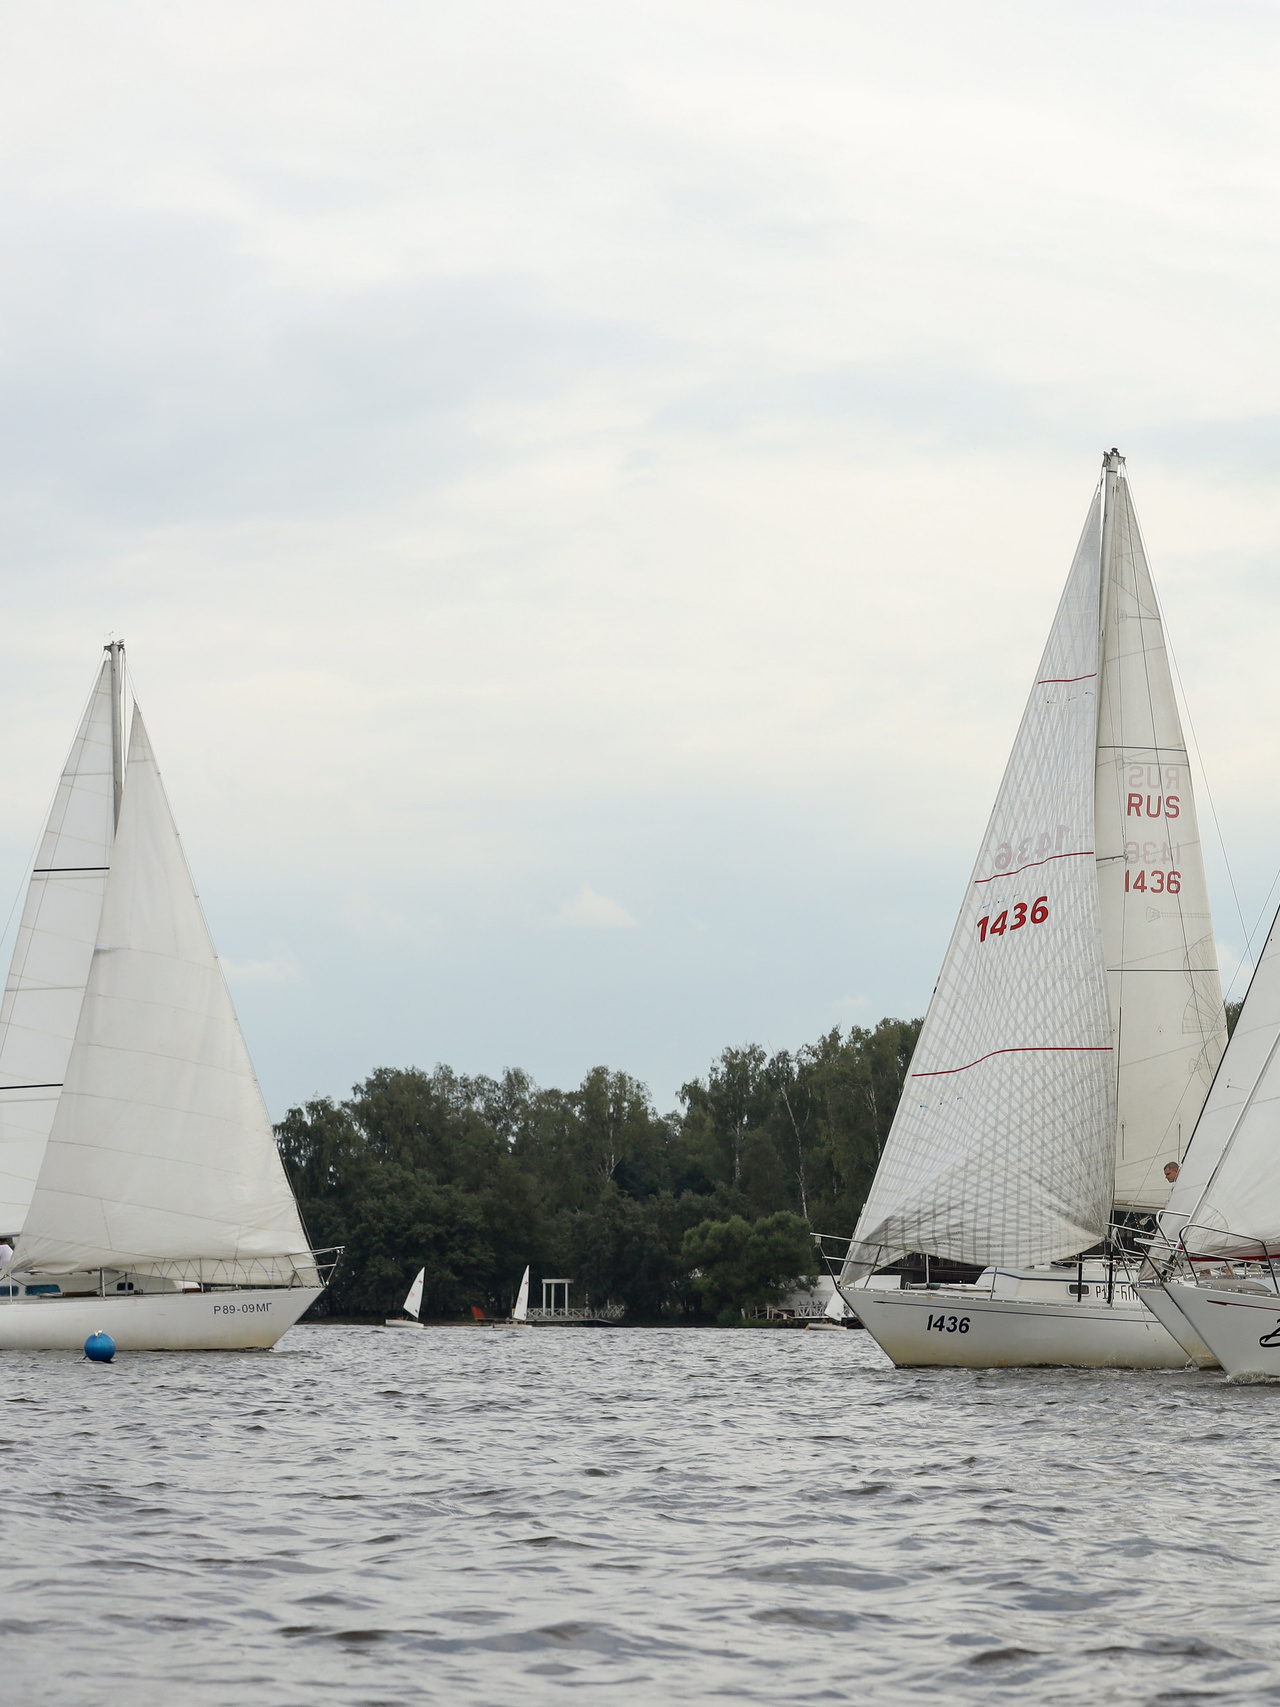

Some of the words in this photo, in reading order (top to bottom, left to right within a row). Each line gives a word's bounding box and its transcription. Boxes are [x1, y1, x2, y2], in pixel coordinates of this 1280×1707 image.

[1127, 793, 1180, 819] RUS
[1125, 870, 1182, 894] 1436
[977, 896, 1049, 943] 1436
[926, 1314, 971, 1334] 1436
